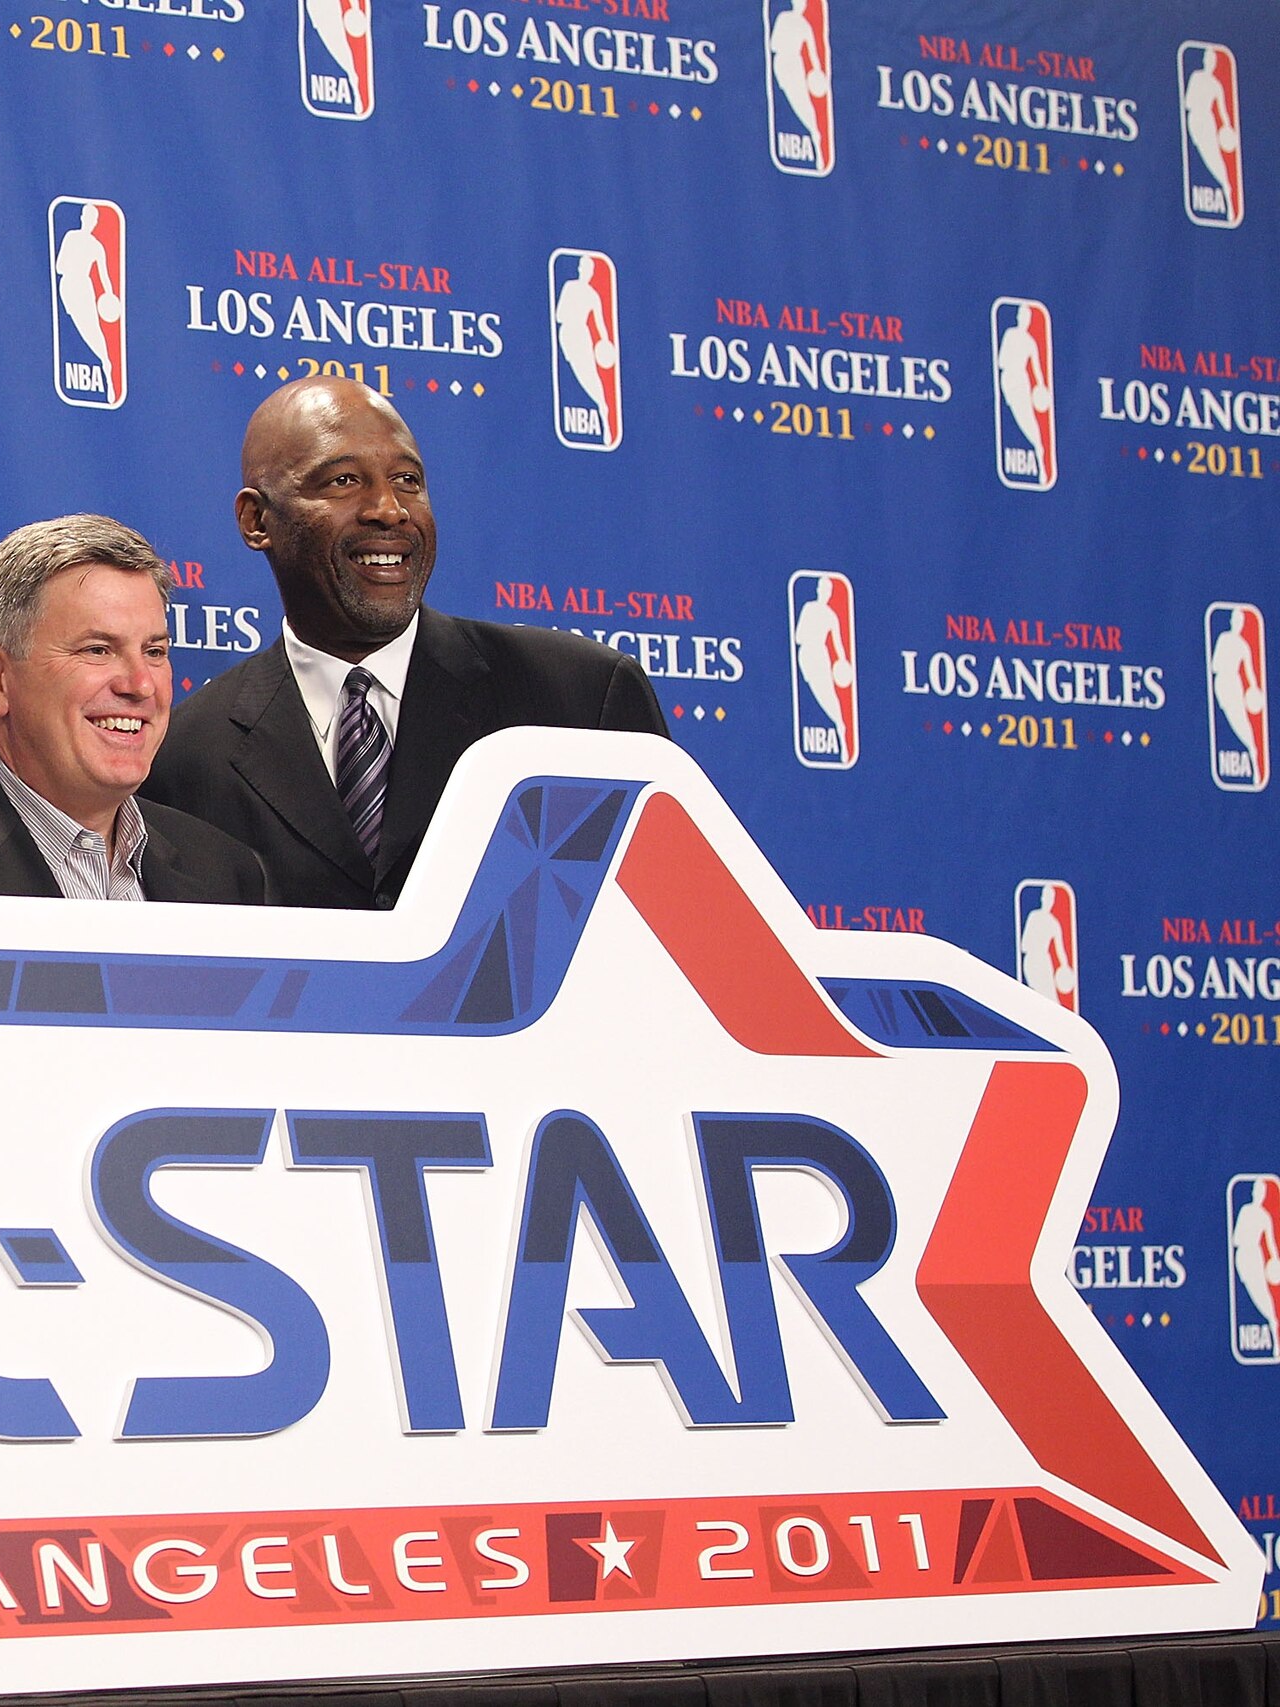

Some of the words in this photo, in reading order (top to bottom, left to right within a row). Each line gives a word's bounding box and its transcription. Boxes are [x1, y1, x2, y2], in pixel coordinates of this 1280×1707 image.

[31, 16, 130, 58] 2011
[423, 4, 509, 57] LOS
[516, 17, 719, 84] ANGELES
[920, 35, 971, 65] NBA
[979, 45, 1095, 81] ALL-STAR
[310, 74, 352, 105] NBA
[530, 76, 619, 118] 2011
[877, 65, 954, 116] LOS
[961, 78, 1138, 141] ANGELES
[778, 131, 814, 161] NBA
[972, 135, 1051, 174] 2011
[1192, 185, 1227, 214] NBA
[234, 249, 298, 282] NBA
[307, 257, 452, 294] ALL-STAR
[186, 285, 275, 338] LOS
[282, 299, 503, 358] ANGELES
[715, 299, 770, 328] NBA
[778, 307, 904, 342] ALL-STAR
[65, 362, 105, 393] NBA
[670, 333, 751, 383] LOS
[757, 342, 952, 403] ANGELES
[1140, 344, 1187, 373] NBA
[563, 405, 602, 436] NBA
[770, 402, 856, 440] 2011
[1098, 377, 1171, 426] LOS
[1175, 385, 1280, 436] ANGE
[1004, 447, 1038, 476] NBA
[1186, 441, 1264, 479] 2011
[495, 581, 554, 611] NBA
[562, 587, 695, 621] ALL-STAR
[946, 614, 997, 643] NBA
[1004, 620, 1123, 652] ALL-STAR
[901, 650, 979, 698] LOS
[985, 656, 1165, 710] ANGELES
[803, 726, 839, 754] NBA
[997, 714, 1078, 750] 2011
[1218, 750, 1252, 778] NBA
[1162, 917, 1212, 944] NBA
[1120, 954, 1195, 999] LOS
[1082, 1206, 1145, 1233] STAR
[1066, 1244, 1187, 1290] GELES
[1239, 1323, 1272, 1350] NBA
[695, 1513, 931, 1581] 2011
